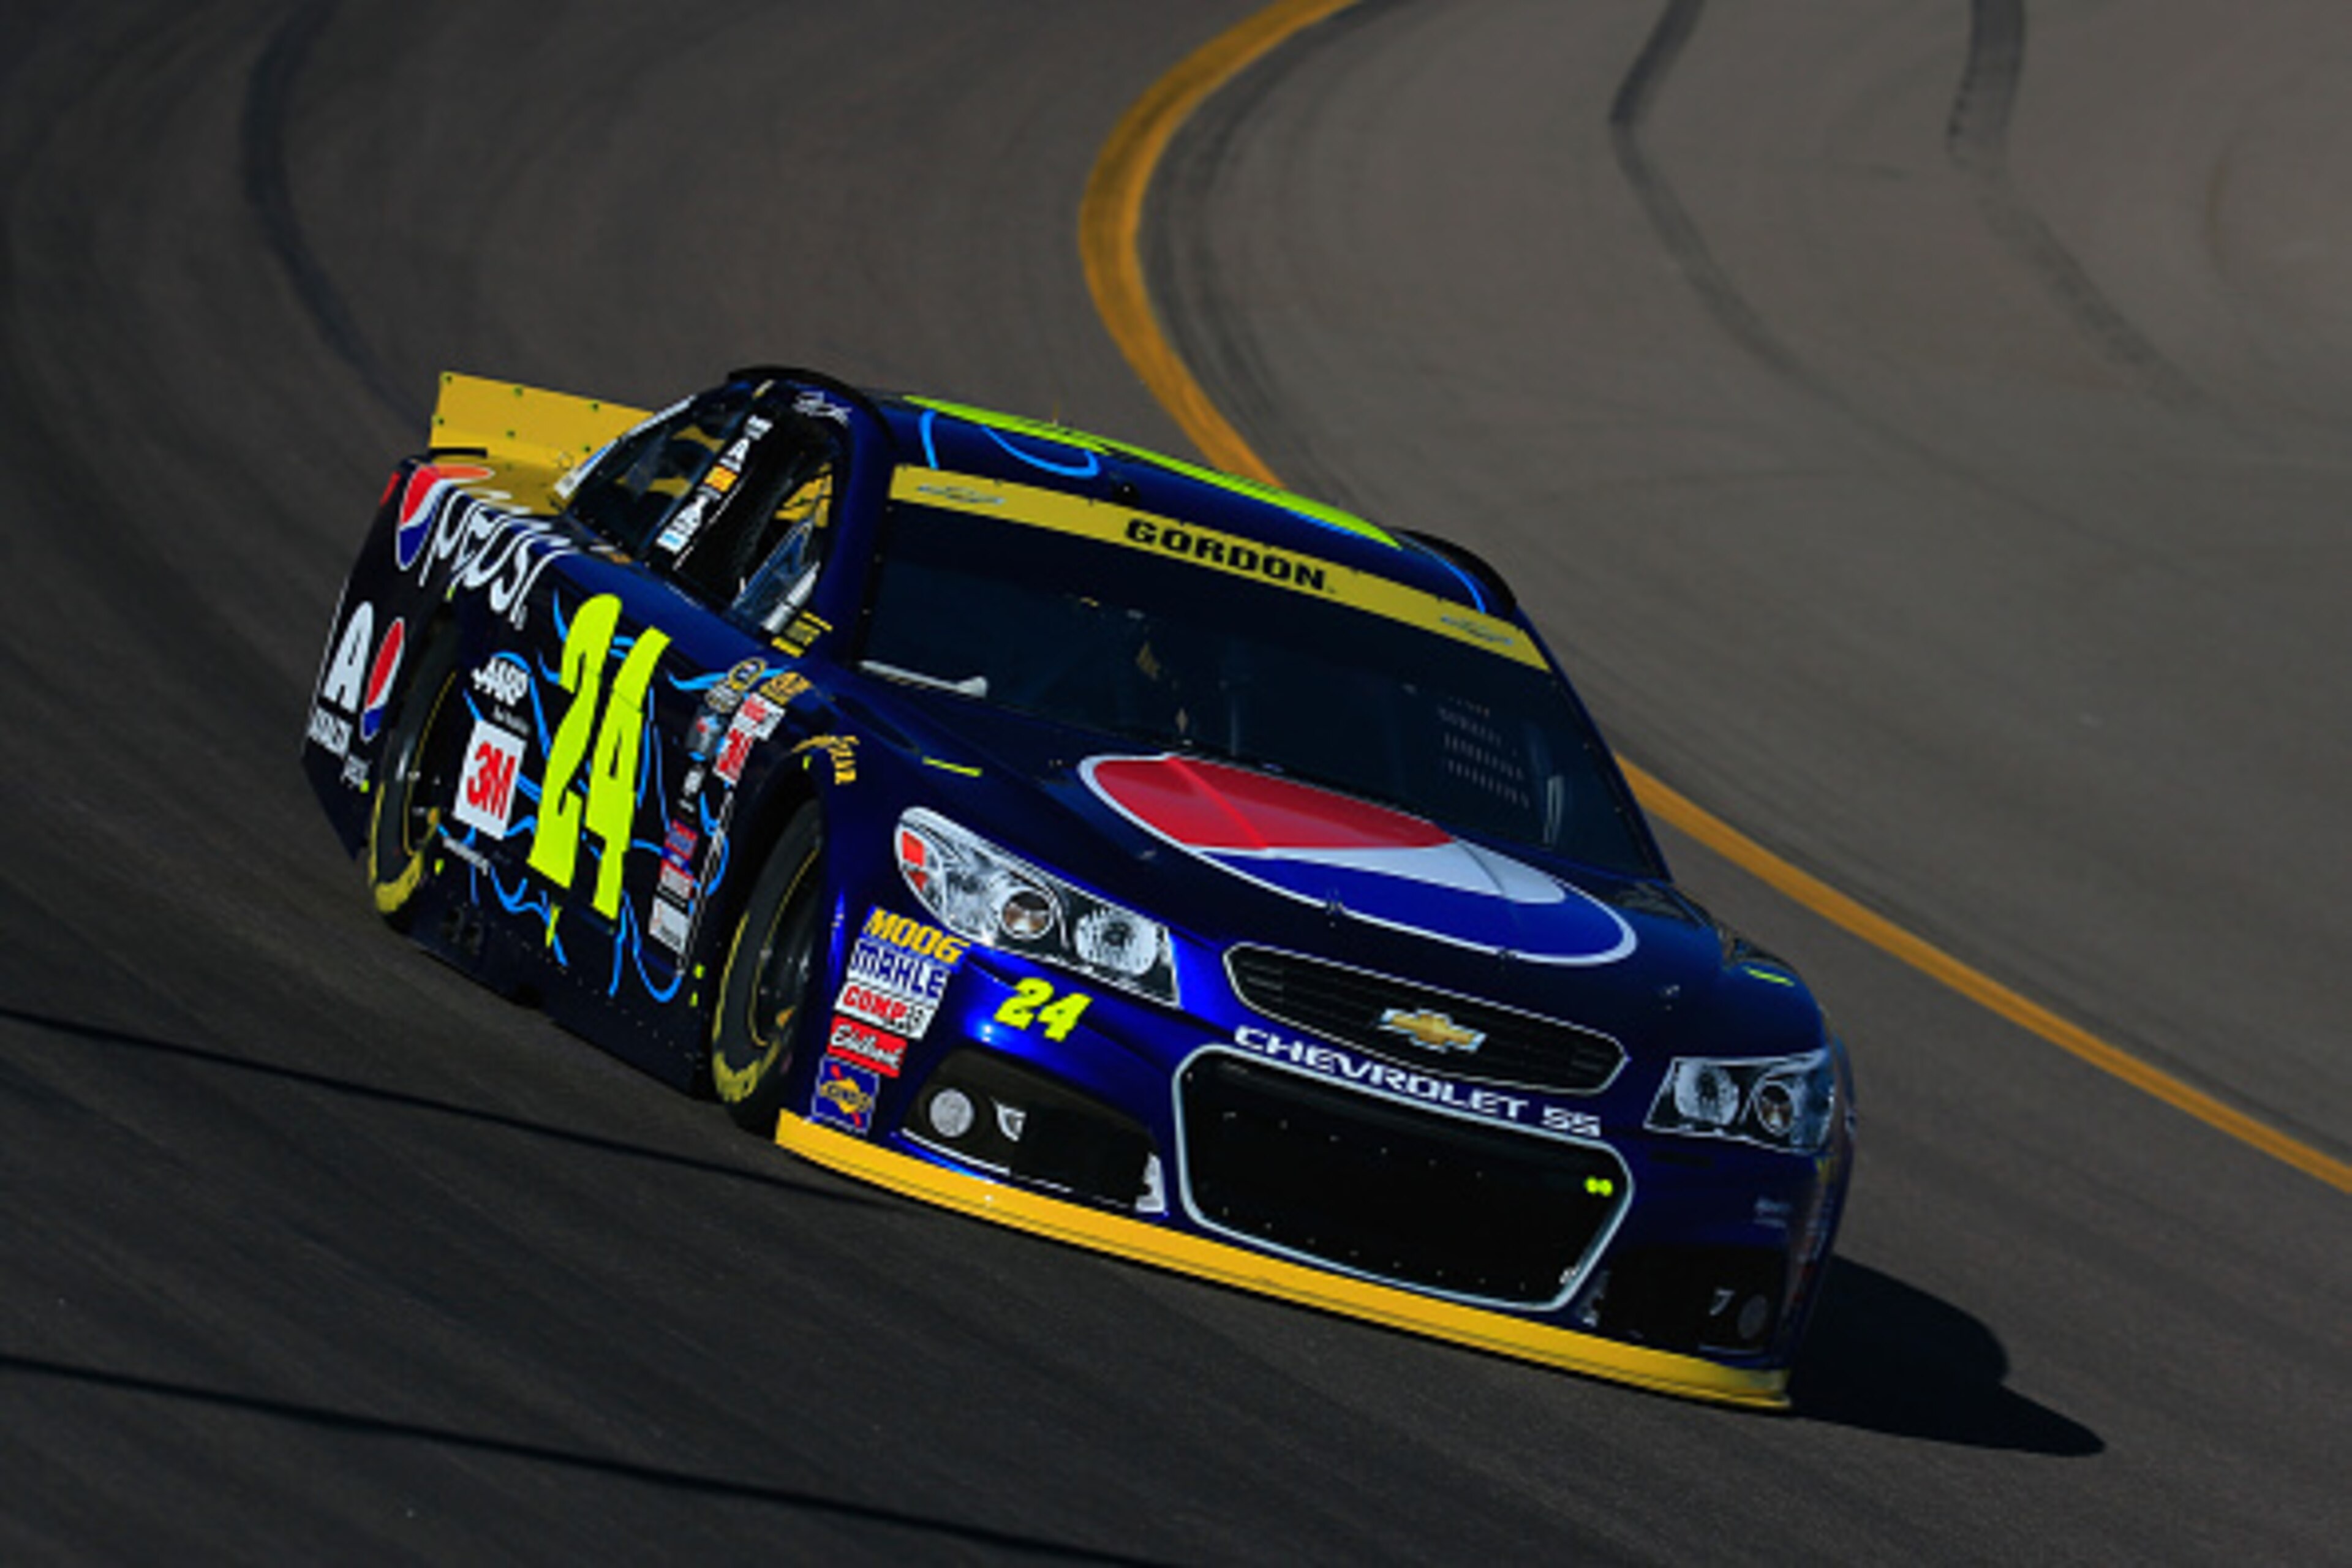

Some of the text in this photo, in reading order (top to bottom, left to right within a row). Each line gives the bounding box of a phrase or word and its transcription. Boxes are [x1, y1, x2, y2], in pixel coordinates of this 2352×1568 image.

[1126, 518, 1325, 590] GORDON
[467, 741, 516, 820] 3M
[526, 592, 671, 919] 24
[862, 907, 971, 964] MOOG
[843, 985, 908, 1019] COMP
[850, 941, 947, 1000] MAHLE
[995, 978, 1092, 1042] 24
[1234, 1025, 1601, 1137] CHEVROLET SS
